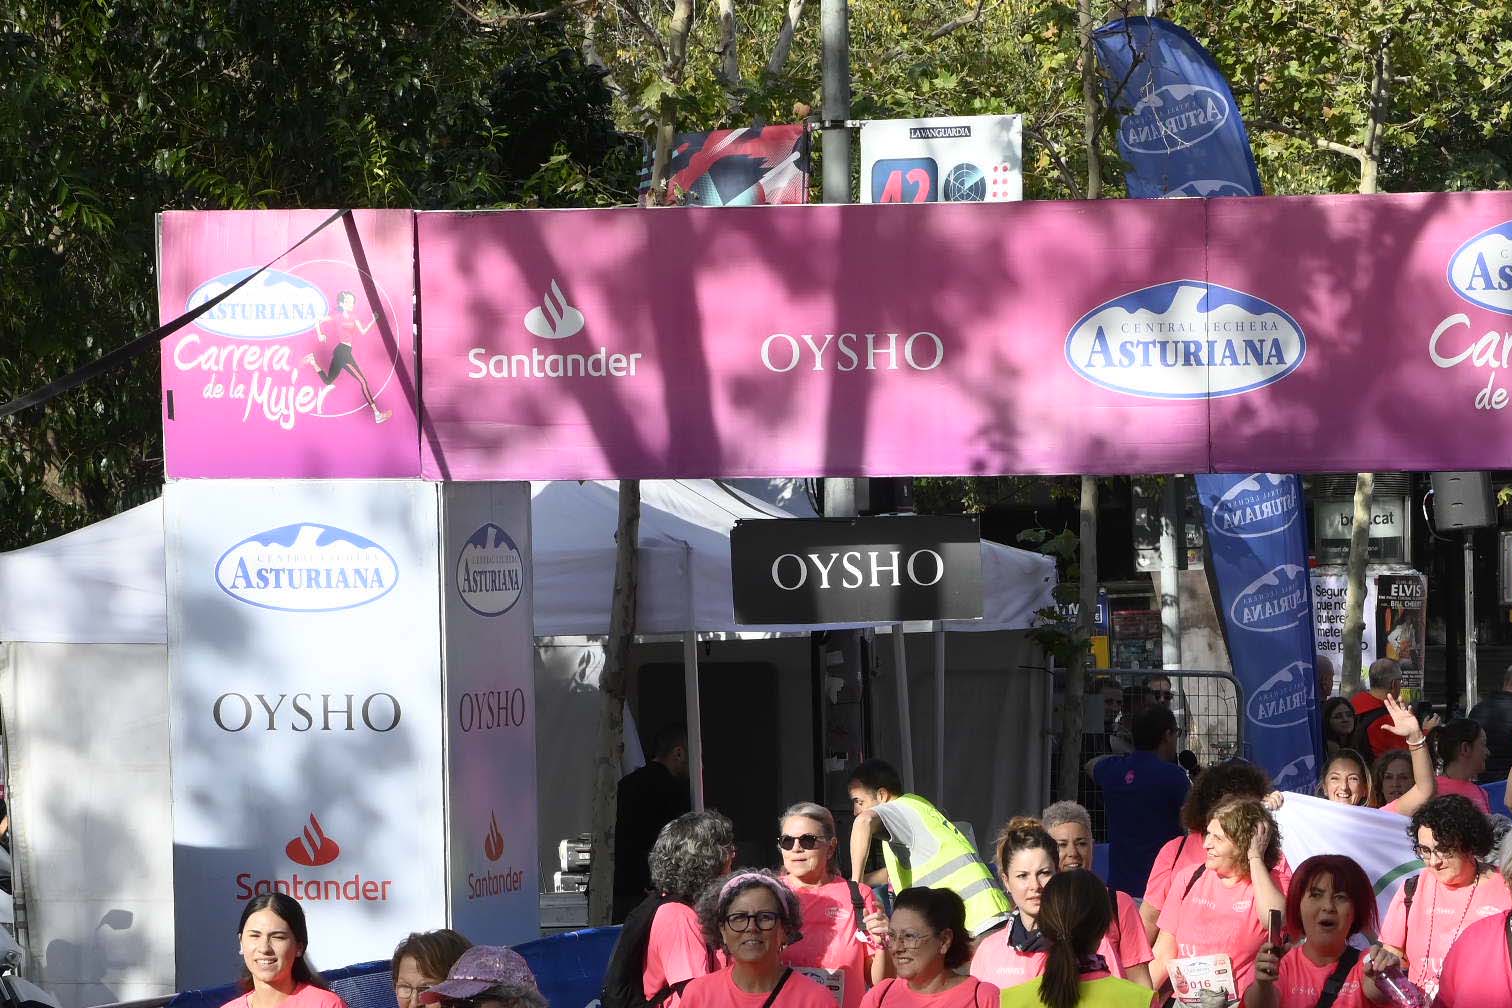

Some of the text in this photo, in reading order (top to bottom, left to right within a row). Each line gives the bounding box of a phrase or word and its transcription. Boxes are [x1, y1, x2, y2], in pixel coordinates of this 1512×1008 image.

[920, 126, 970, 138] VANGUARDIA
[193, 285, 318, 323] ASTURIANA
[1120, 319, 1281, 334] CENTRAL LECHERA
[174, 334, 294, 373] Carrera
[468, 346, 643, 381] Santander
[760, 330, 945, 373] OYSHO
[1085, 324, 1289, 370] ASTURIANA
[203, 366, 336, 430] de la Mujer
[1474, 370, 1510, 411] de
[229, 555, 385, 591] ASTURIANA
[461, 562, 521, 594] ASTURIANA
[771, 549, 944, 591] OYSHO
[1317, 602, 1333, 614] que
[1391, 584, 1421, 597] ELVIS
[1317, 642, 1336, 651] este
[213, 692, 402, 733] OYSHO
[459, 687, 526, 733] OYSHO
[236, 872, 392, 902] Santander
[468, 866, 523, 901] Santander
